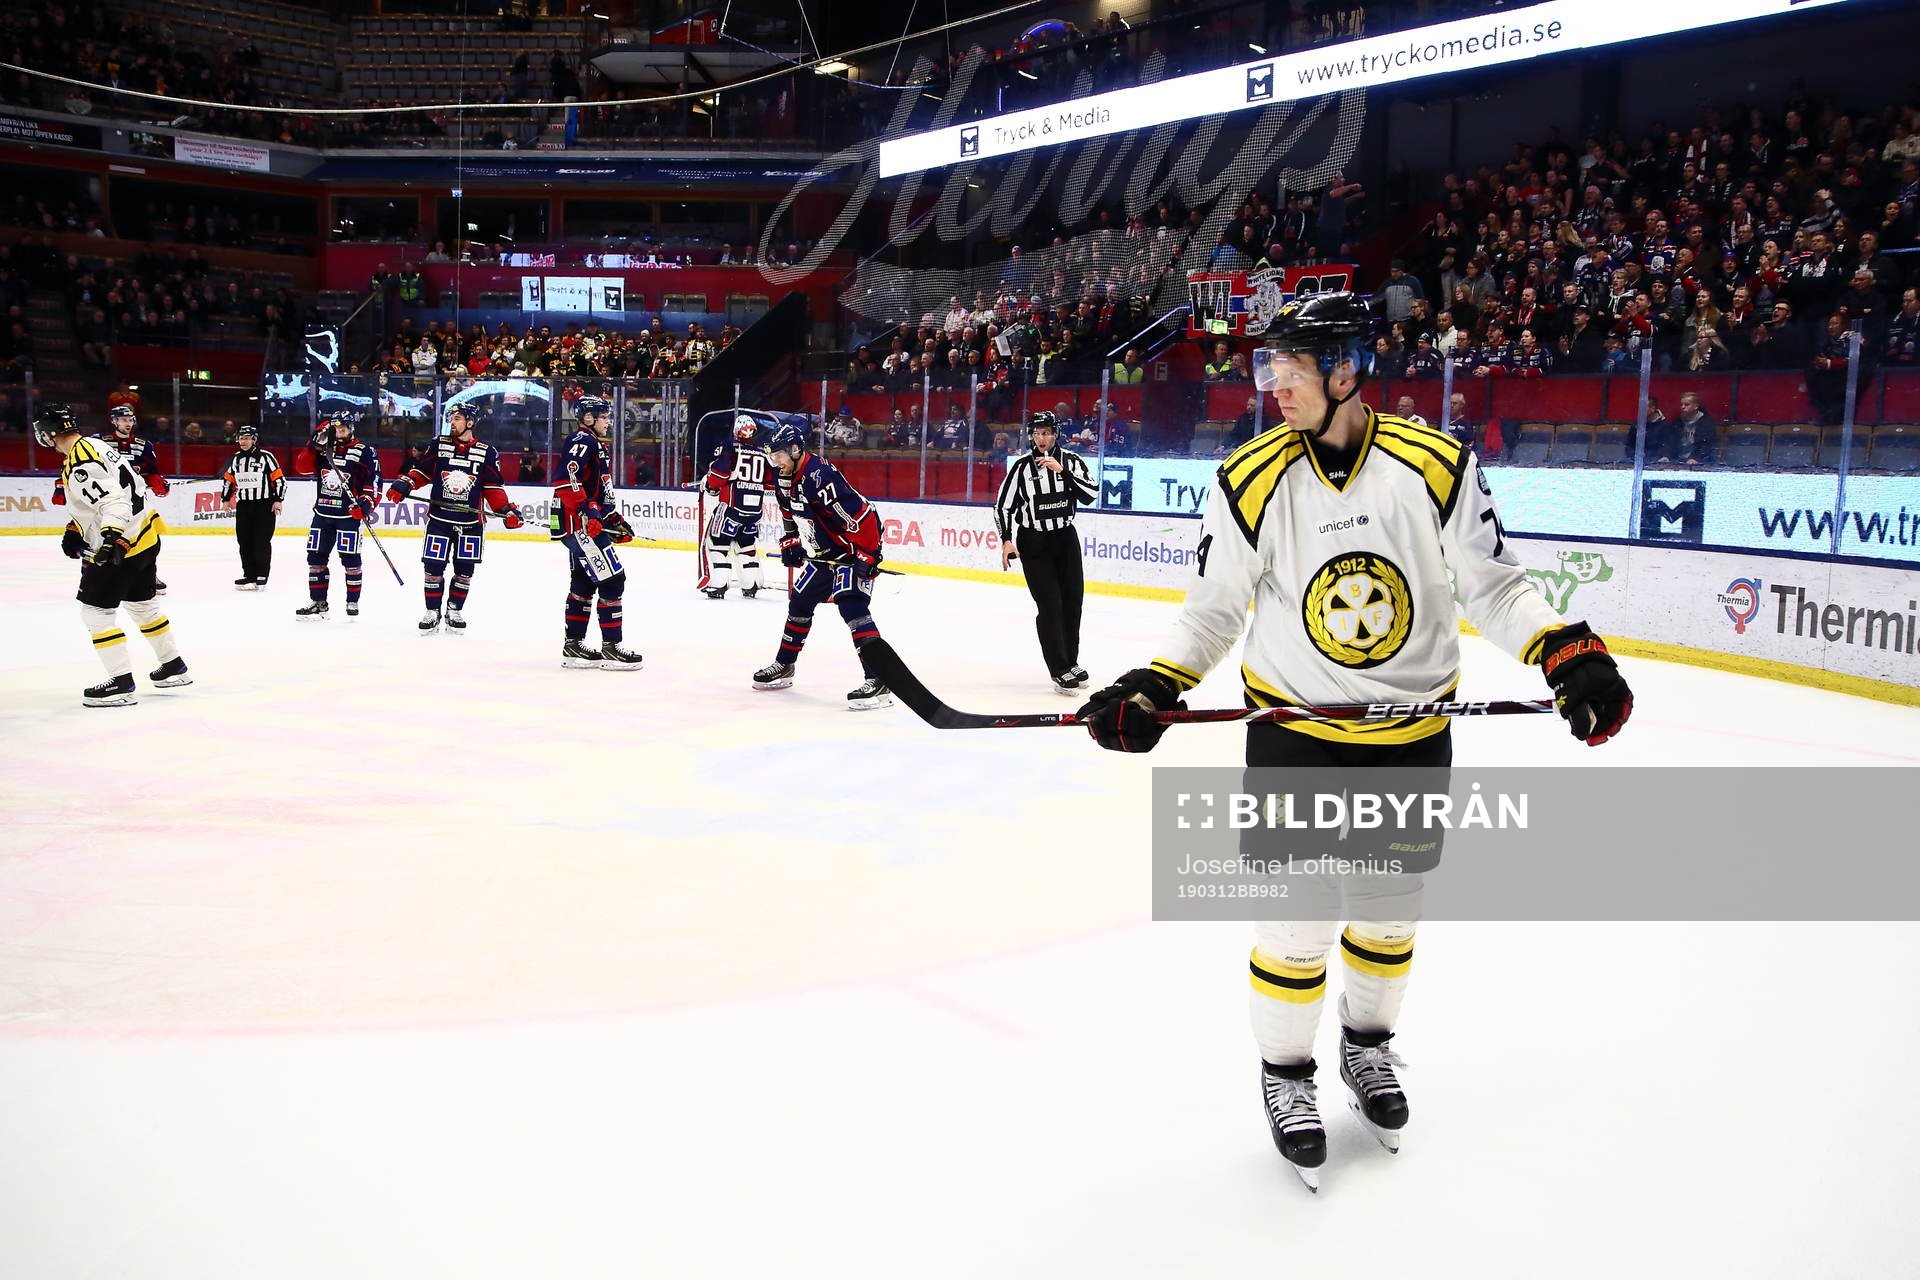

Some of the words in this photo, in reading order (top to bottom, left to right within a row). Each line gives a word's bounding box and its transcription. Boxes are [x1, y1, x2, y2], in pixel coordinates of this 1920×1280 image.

[1297, 20, 1563, 85] www.tryckomedia.se
[994, 125, 1037, 145] Tryck
[1041, 118, 1053, 135] &
[1059, 107, 1111, 131] Media
[568, 443, 588, 458] 47
[738, 454, 765, 483] 50
[1328, 471, 1347, 480] SHL
[82, 481, 109, 505] 11
[195, 491, 236, 513] RI
[817, 482, 838, 506] 27
[1160, 478, 1210, 513] Try
[1038, 499, 1069, 511] swedol
[1318, 516, 1355, 534] unicef
[1334, 557, 1367, 576] 1912
[1349, 583, 1361, 598] B
[1716, 593, 1750, 607] Thermia
[1372, 610, 1383, 627] F
[1770, 583, 1920, 655] Thermi
